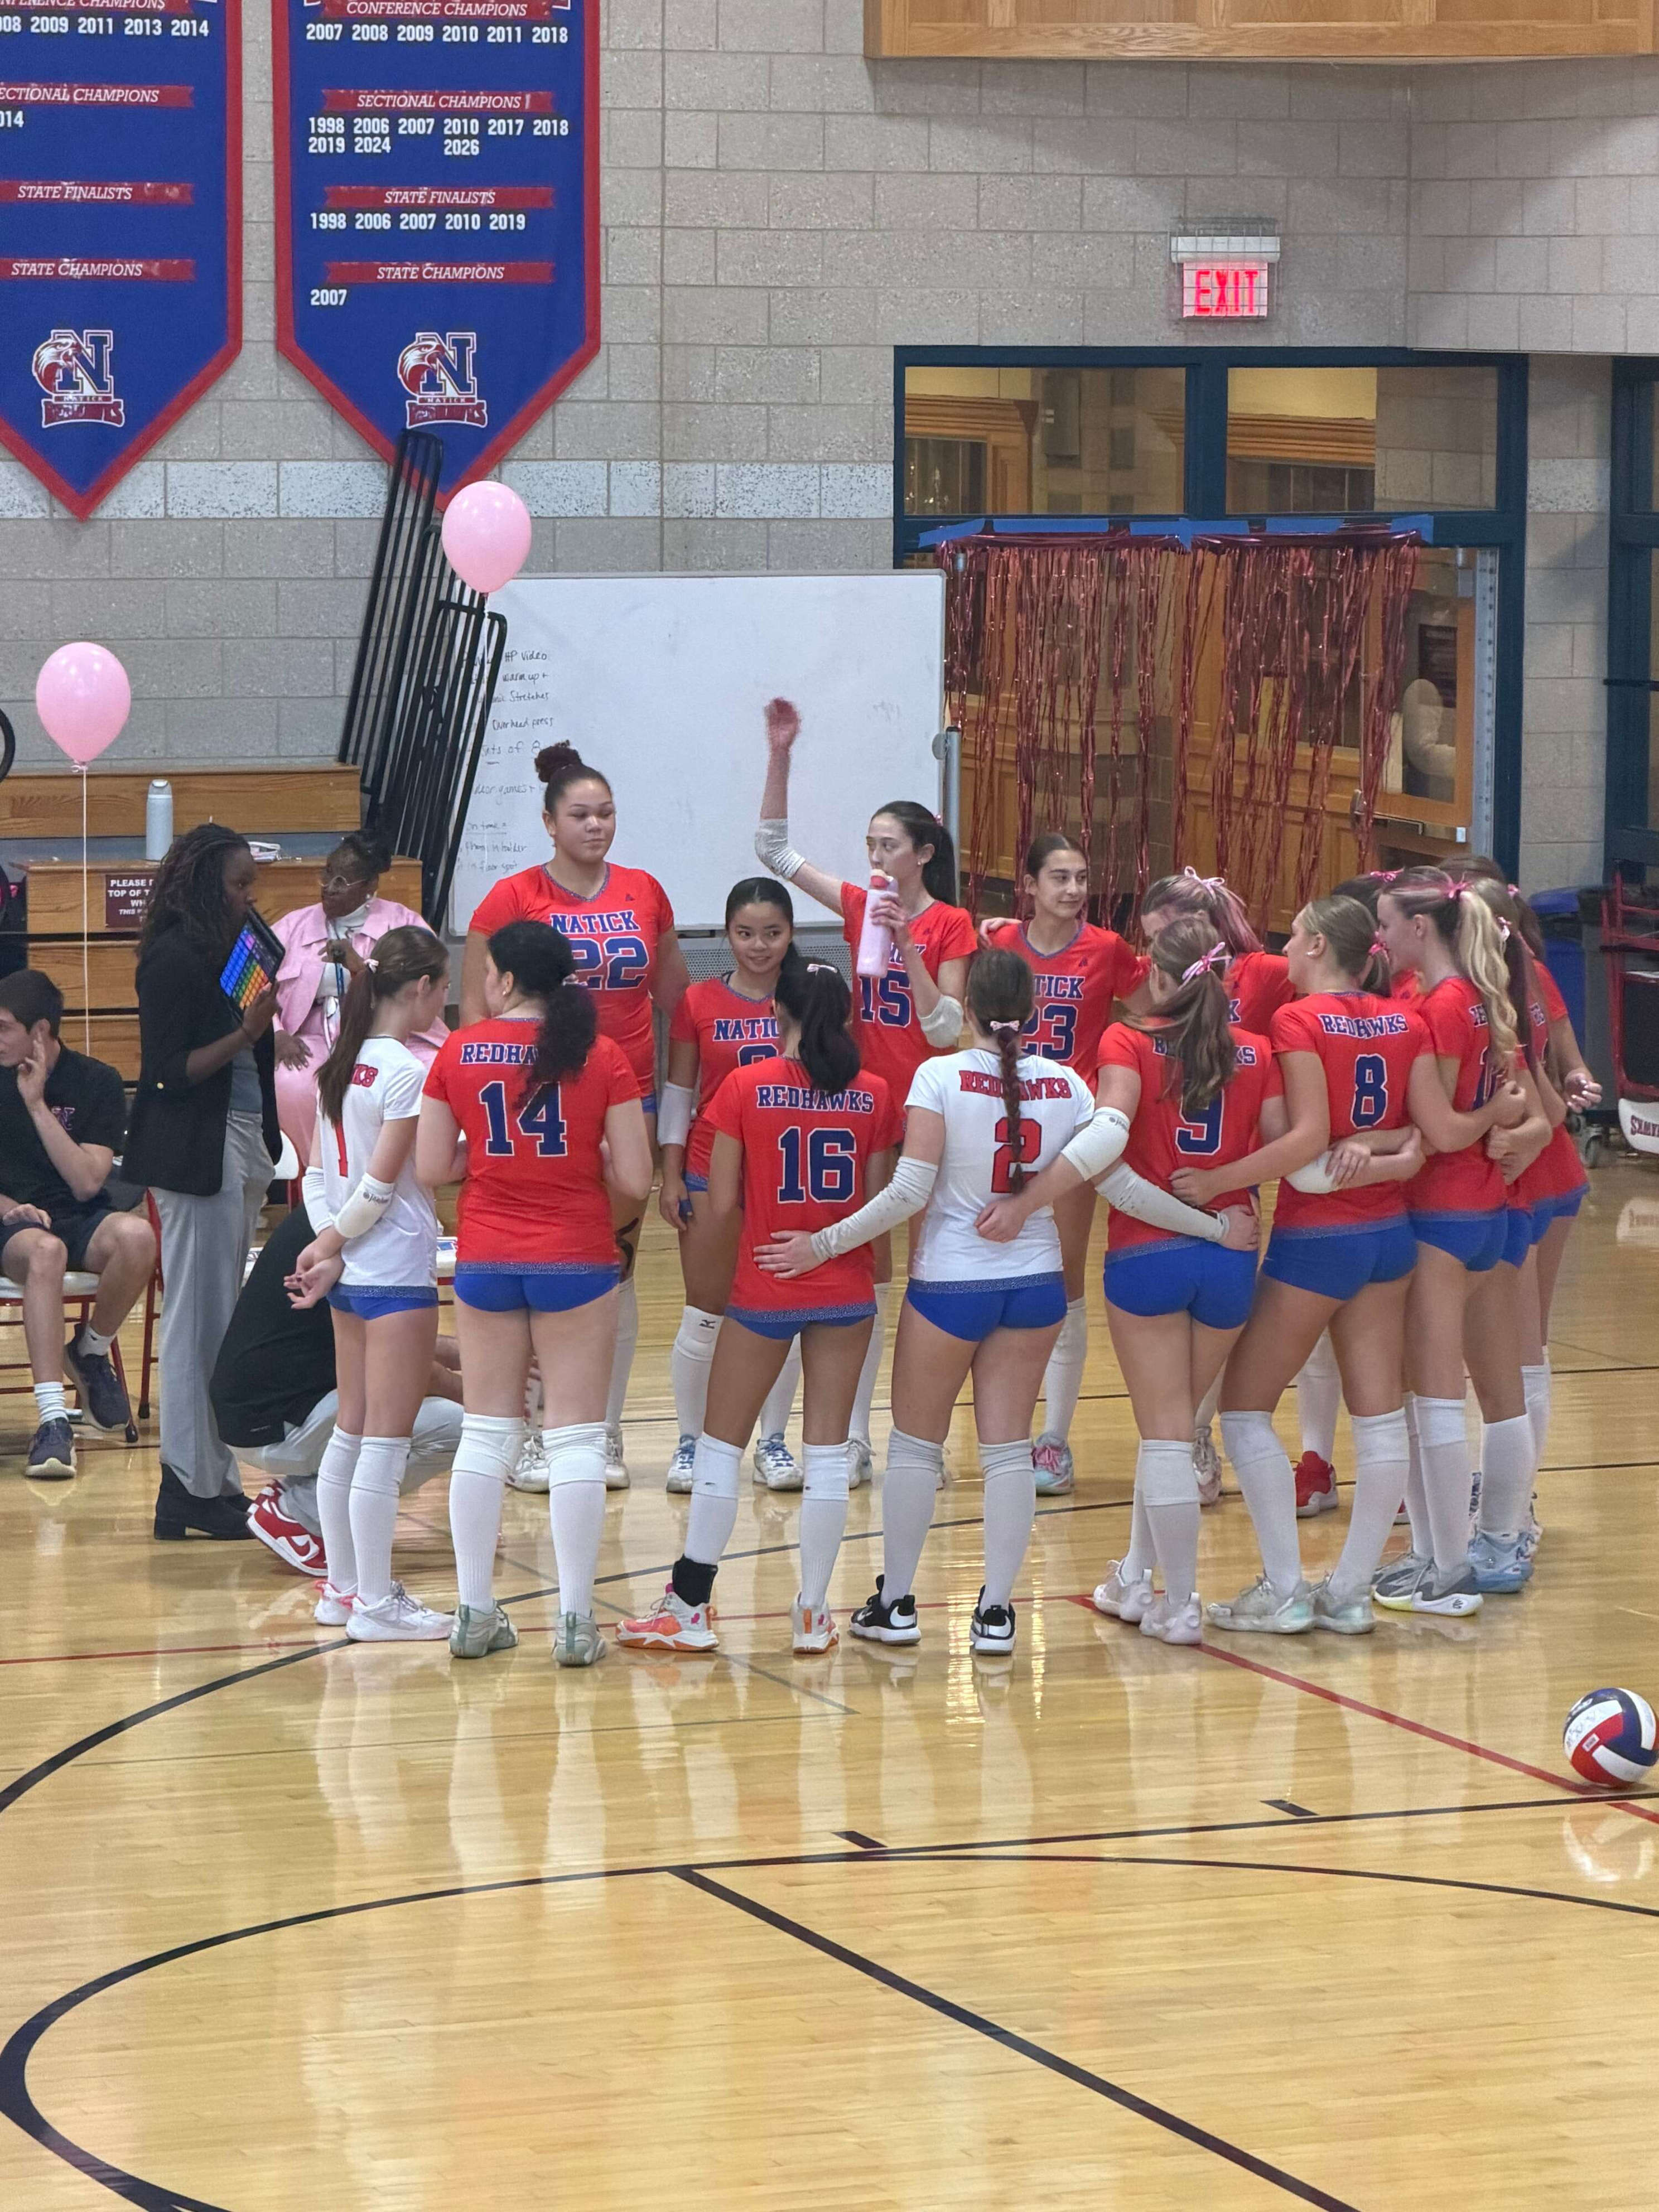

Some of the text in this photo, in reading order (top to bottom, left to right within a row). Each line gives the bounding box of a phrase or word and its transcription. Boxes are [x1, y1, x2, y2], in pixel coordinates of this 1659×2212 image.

[346, 2, 528, 16] CONFERENCE CHAMPIONS
[0, 16, 209, 37] 08 2009 2011 2013 2014
[306, 23, 568, 44] 2007 2008 2009 2010 2011 2018
[0, 87, 160, 103] ECTIONAL CHAMPIONS
[357, 94, 522, 108] SECTIONAL CHAMPIONS
[0, 110, 25, 128] 014
[308, 117, 569, 136] 1998 2006 2007 2010 2017 2018
[308, 137, 480, 156] 2019 2024 2026
[17, 186, 133, 200] STATE FINALISTS
[384, 191, 495, 205] STATE FINALISTS
[310, 212, 525, 231] 1998 2006 2007 2010 2019
[11, 263, 143, 277] STATE CHAMPIONS
[377, 266, 505, 280] STATE CHAMPIONS
[310, 289, 347, 306] 2007
[1195, 271, 1259, 314] EXIT
[550, 910, 641, 935] NATICK
[568, 935, 649, 991] 22
[859, 967, 912, 1028] 15
[1033, 973, 1086, 1001] TICK
[460, 1042, 539, 1065] REDHA
[755, 1084, 875, 1114] REDHAWKS
[1351, 1053, 1388, 1129] 8
[479, 1080, 568, 1157] 14
[777, 1126, 857, 1204] 16
[991, 1116, 1042, 1193] 2
